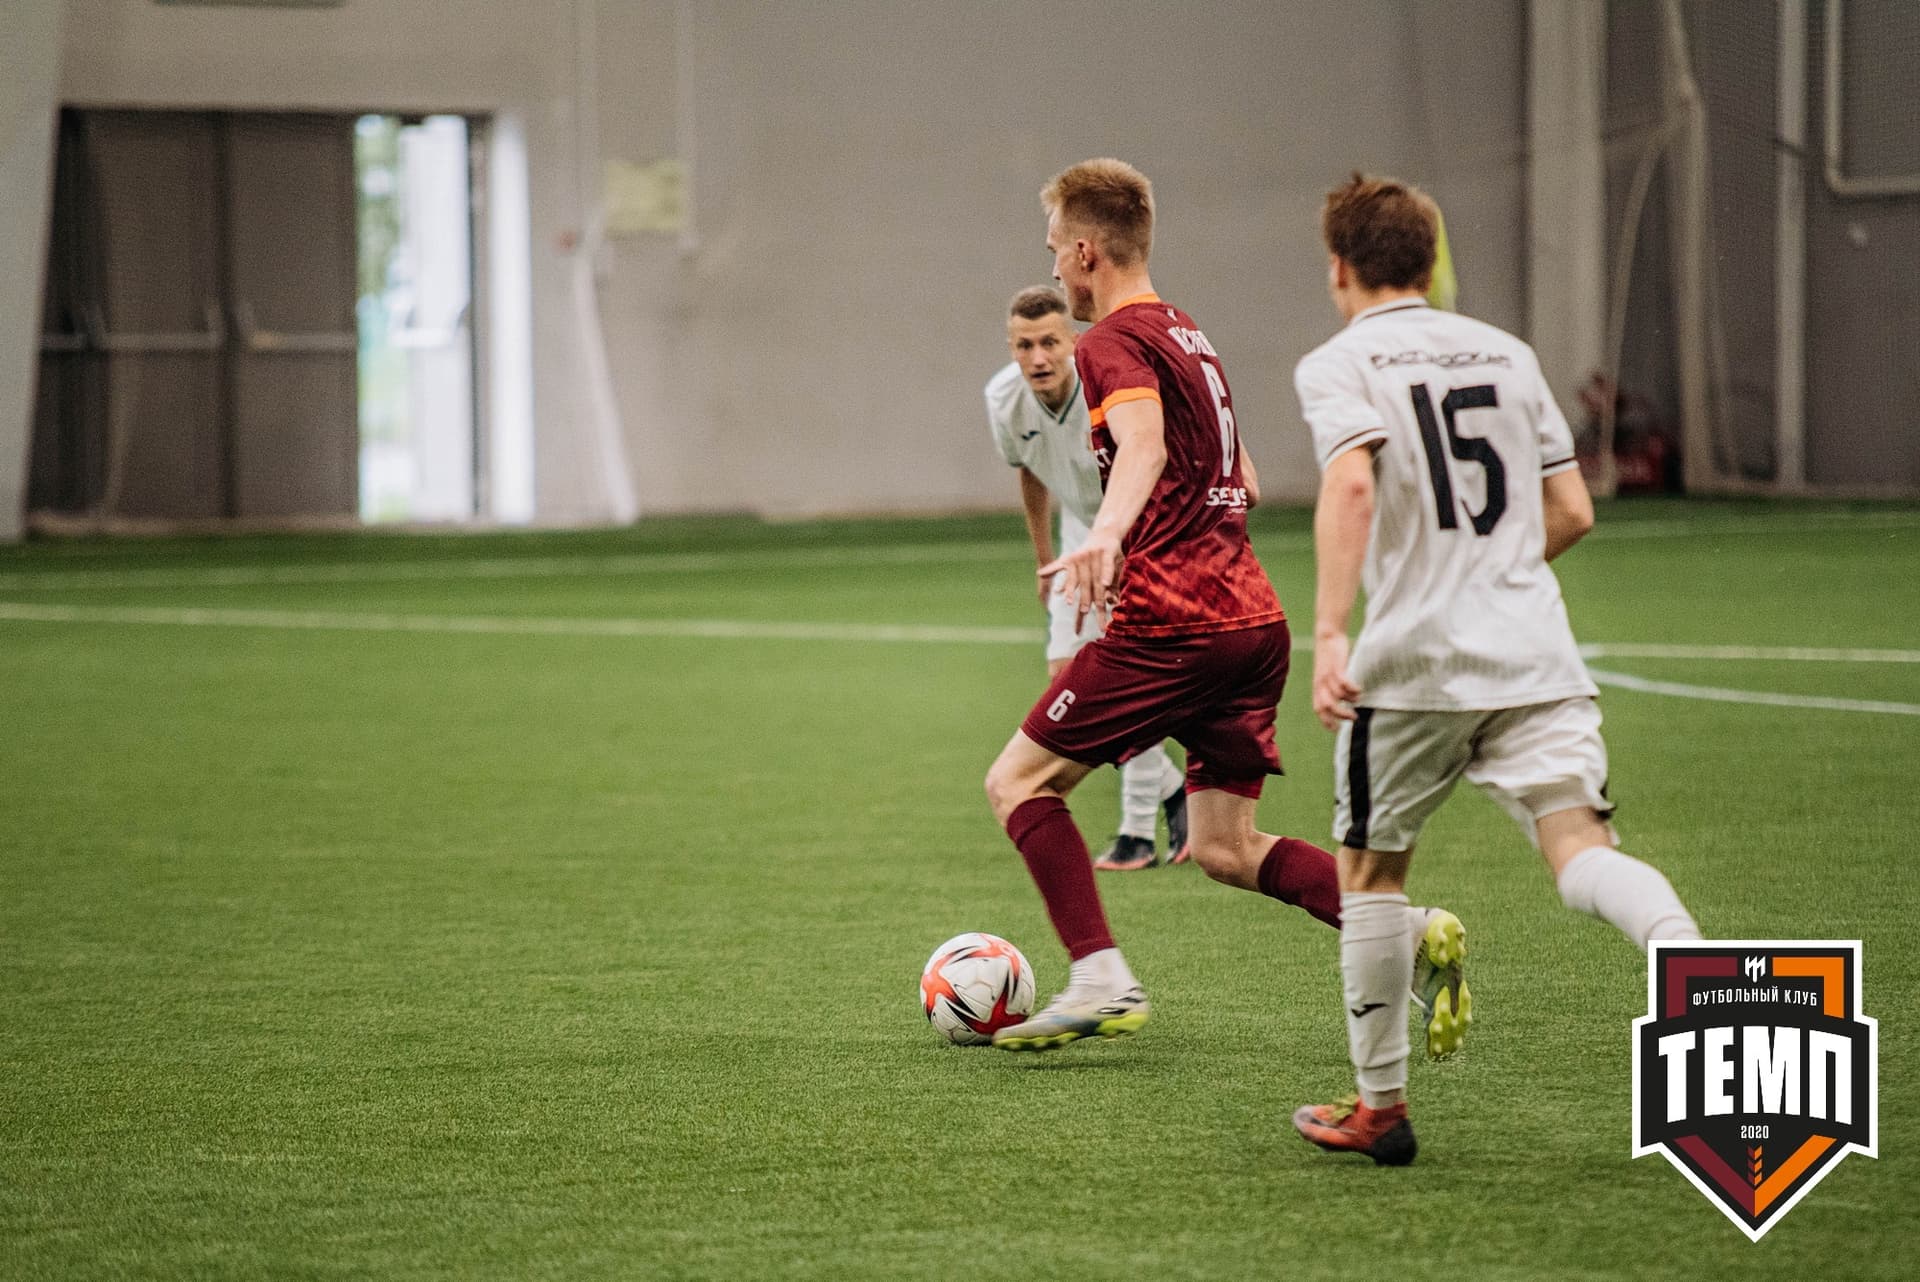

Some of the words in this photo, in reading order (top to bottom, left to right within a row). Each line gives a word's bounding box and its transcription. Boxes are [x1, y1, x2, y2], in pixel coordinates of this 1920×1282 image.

[1200, 361, 1235, 477] 6
[1410, 384, 1507, 535] 15
[1046, 689, 1076, 722] 6
